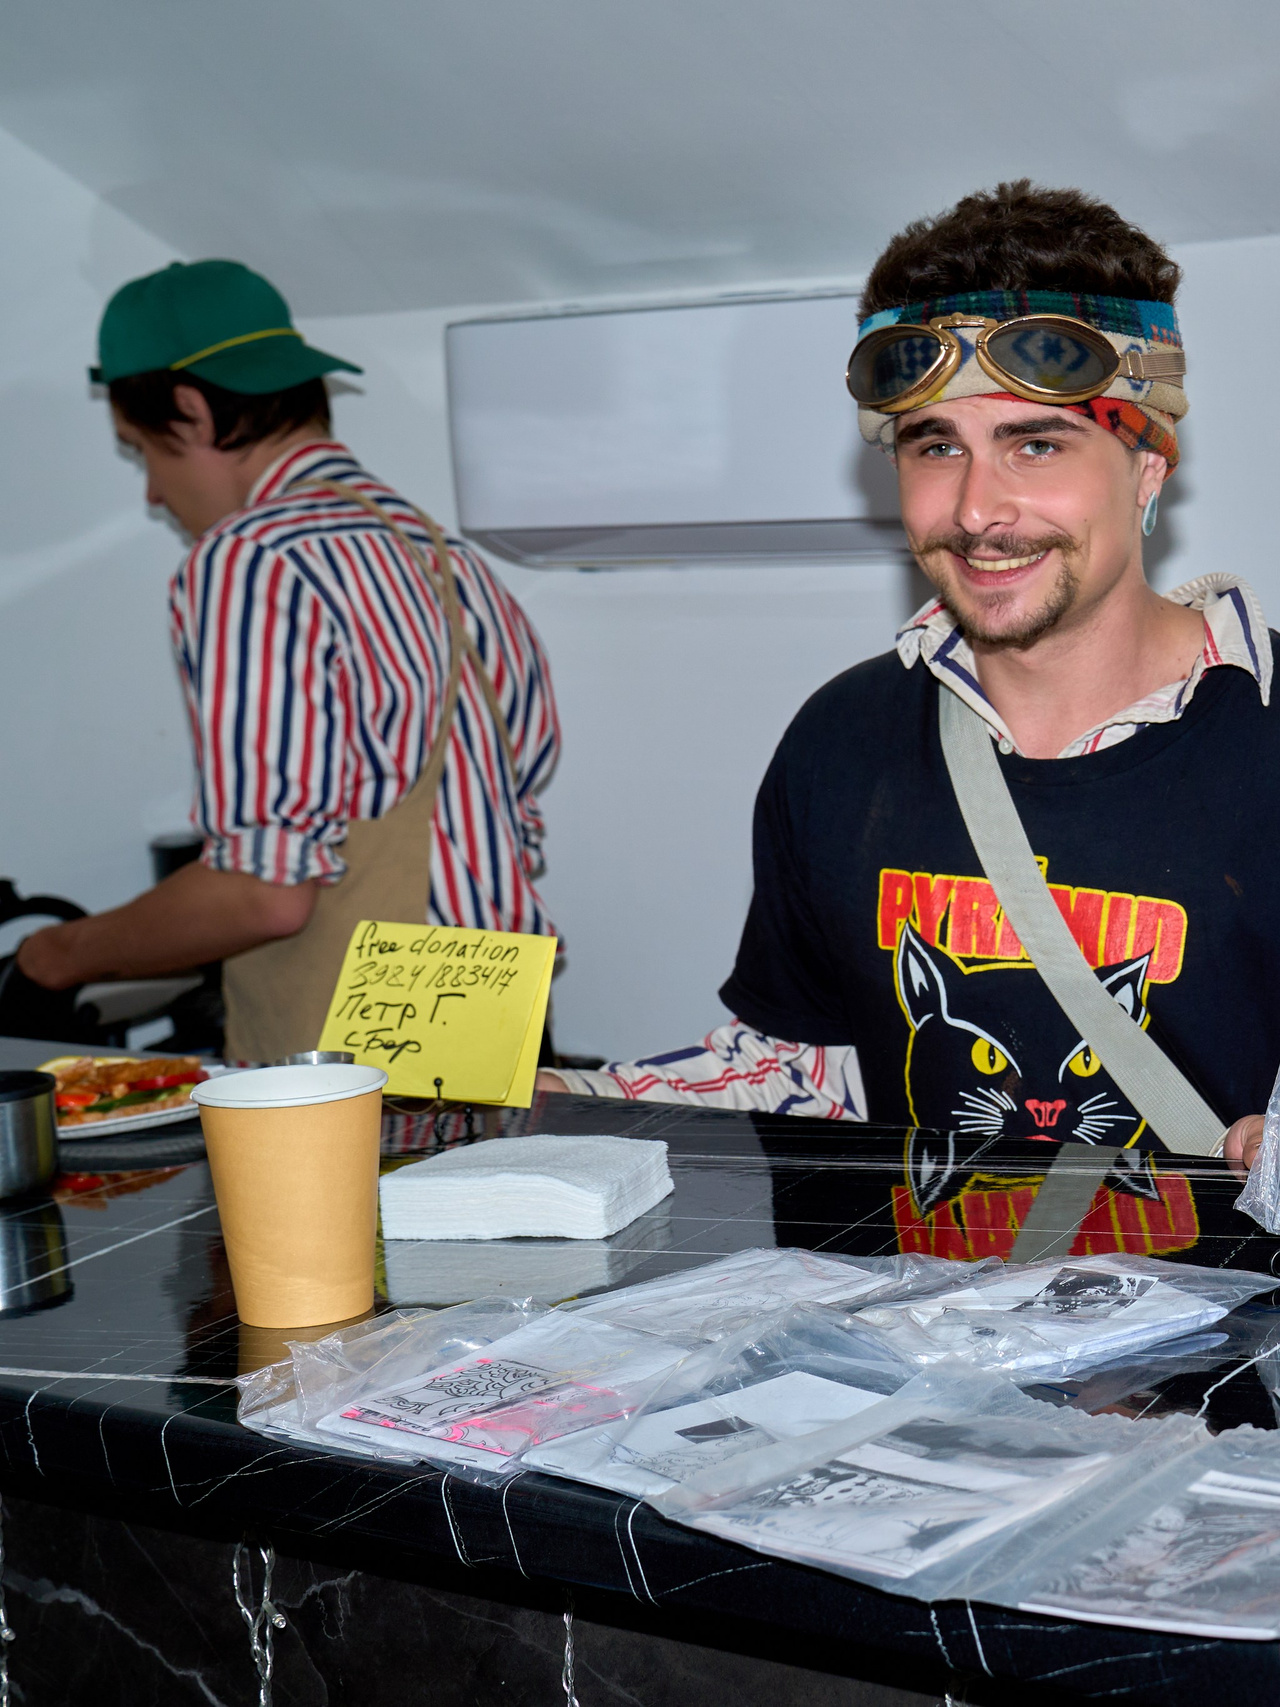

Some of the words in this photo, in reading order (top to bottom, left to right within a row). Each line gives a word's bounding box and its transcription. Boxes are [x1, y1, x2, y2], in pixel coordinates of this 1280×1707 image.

[356, 922, 404, 960] free
[410, 928, 519, 963] donation
[336, 992, 417, 1029] Петр
